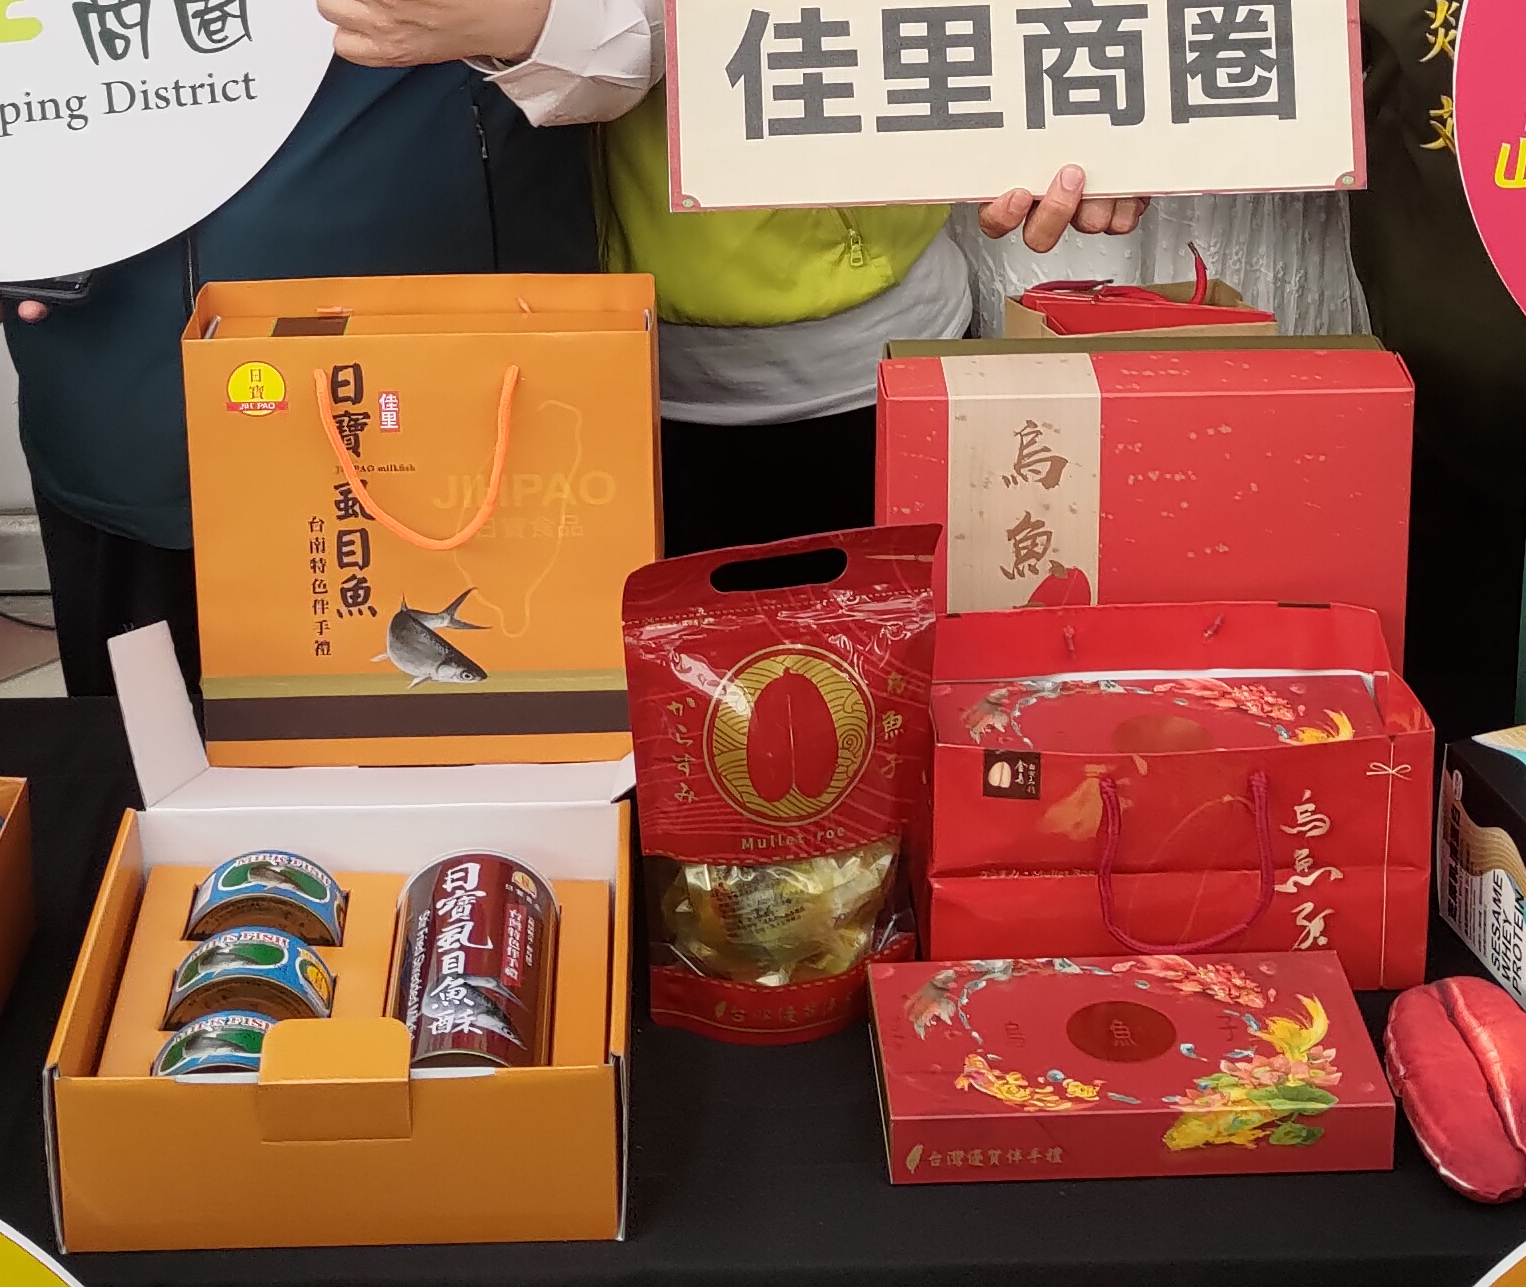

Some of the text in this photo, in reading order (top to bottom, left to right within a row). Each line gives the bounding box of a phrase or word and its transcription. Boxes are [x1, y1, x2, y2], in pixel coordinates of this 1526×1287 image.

[102, 69, 257, 117] District
[379, 392, 399, 430] 佳里
[999, 420, 1068, 581] 烏魚
[741, 833, 805, 851] Mullet
[240, 931, 290, 949] FISH
[1491, 870, 1504, 973] SESAME
[1501, 908, 1513, 981] WHEY
[1512, 888, 1526, 996] PROTEIN
